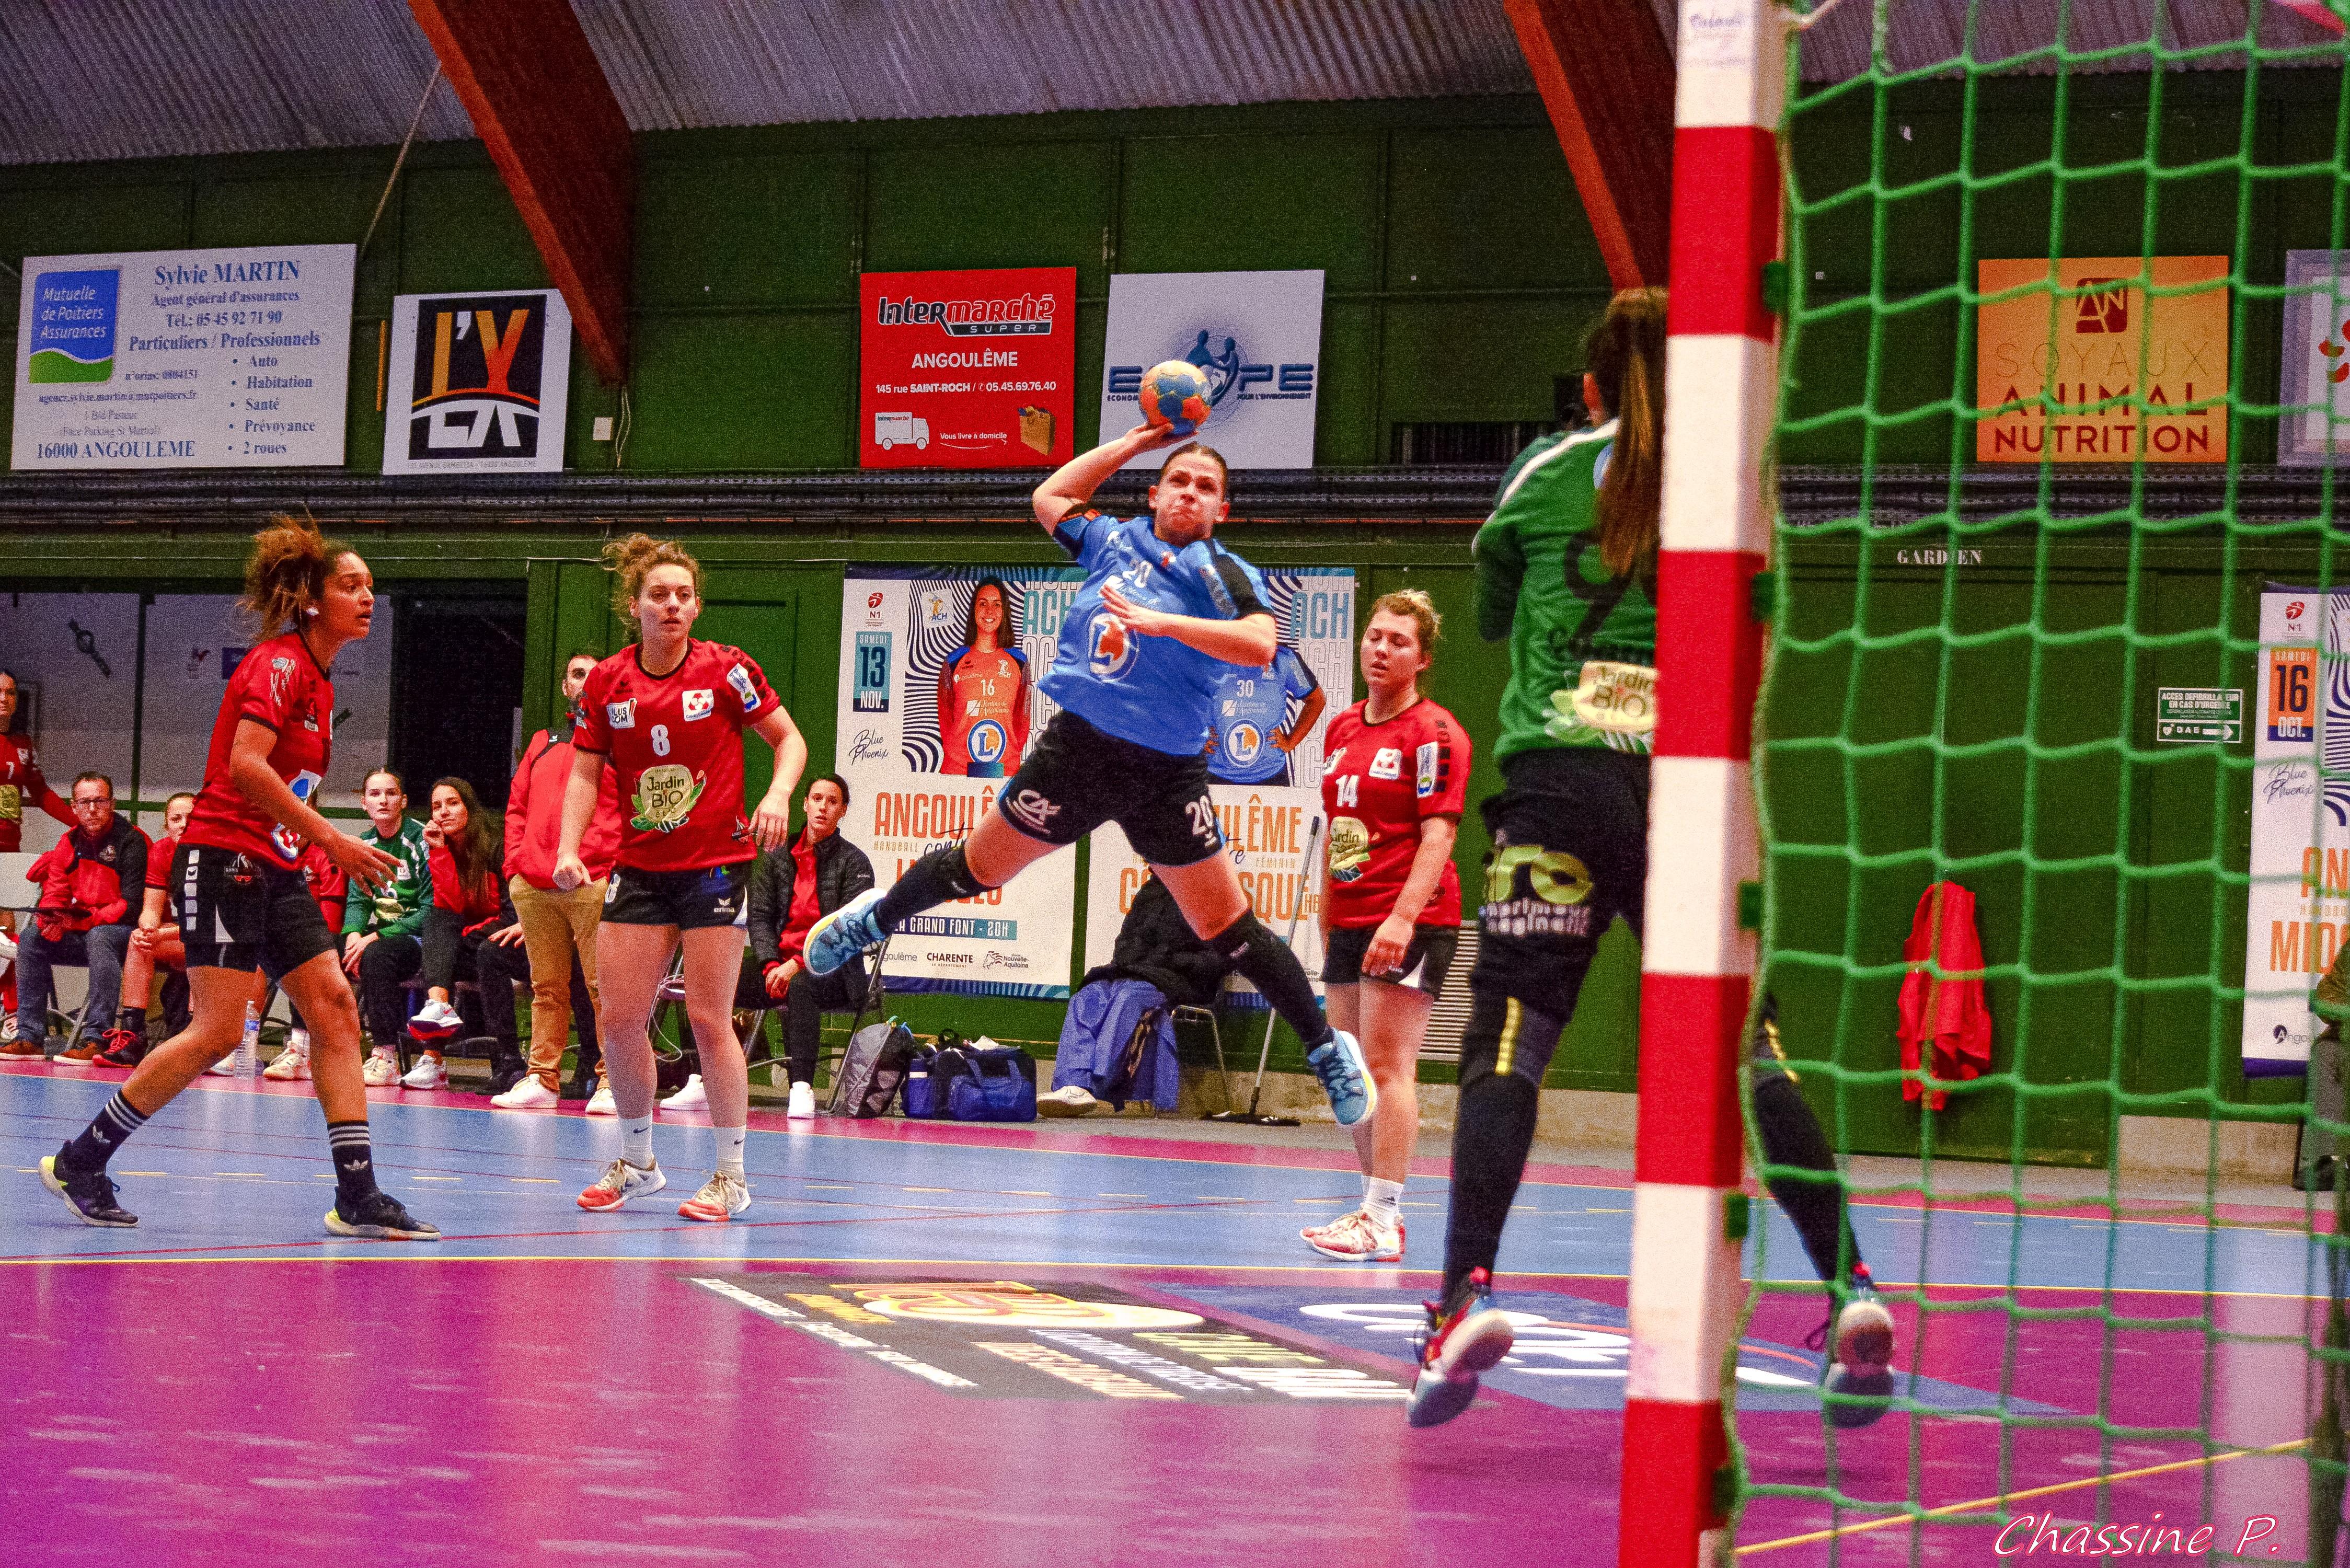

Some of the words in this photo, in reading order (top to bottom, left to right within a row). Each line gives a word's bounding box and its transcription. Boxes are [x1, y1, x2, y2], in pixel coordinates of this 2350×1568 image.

[155, 264, 208, 290] Sylvie
[214, 260, 299, 283] MARTIN
[43, 285, 96, 302] Mutuelle
[151, 294, 183, 308] Agent
[186, 291, 226, 308] général
[229, 290, 300, 303] d'assurances
[42, 307, 55, 321] de
[57, 305, 103, 321] Poitiers
[196, 313, 211, 326] 05
[213, 312, 228, 326] 45
[232, 312, 246, 325] 92
[250, 311, 263, 324] 71
[267, 310, 282, 324] 90
[877, 293, 1056, 335] Intermarché
[40, 324, 106, 339] Assurances
[129, 334, 208, 351] Particuliers
[220, 330, 321, 348] Professionnels
[250, 355, 278, 367] Auto
[911, 348, 1018, 369] ANGOULÊME
[1995, 342, 2209, 377] SOYAUX
[246, 375, 313, 389] Habitation
[876, 384, 892, 394] 145
[910, 383, 971, 393] SAINT-ROCH
[986, 381, 1057, 393] 05.45.69.76.40
[245, 397, 279, 411] Santé
[1997, 382, 2209, 417] ANIMAL
[244, 418, 316, 436] Prévoyance
[979, 431, 1007, 440] domicile
[243, 441, 250, 455] 2
[253, 443, 287, 455] roues
[1995, 425, 2209, 453] NUTRITION
[37, 442, 78, 459] 16000
[81, 440, 195, 459] ANGOULEME
[1123, 559, 1153, 588] 20
[931, 613, 948, 621] ACH
[1290, 592, 1350, 640] ACH
[2287, 624, 2301, 632] N1
[859, 633, 888, 645] SAMEDI
[2275, 651, 2310, 661] SAMEDI
[860, 645, 886, 688] 13
[980, 678, 995, 697] 16
[1236, 679, 1254, 698] 30
[2276, 665, 2309, 712] 16
[860, 690, 884, 710] NOV.
[611, 714, 628, 723] COM
[2277, 716, 2306, 738] OCT.
[650, 724, 671, 756] 8
[854, 729, 884, 748] Blue
[849, 744, 889, 766] Phoenix
[6, 760, 15, 780] 7
[2268, 763, 2307, 780] Blue
[647, 776, 684, 792] Jardin
[1335, 774, 1360, 808] 14
[2263, 779, 2317, 804] Phoenix
[874, 785, 995, 840] ANGOULÊ
[1185, 795, 1214, 836] 20
[874, 840, 918, 852] HANDBALL
[895, 918, 906, 932] A
[909, 917, 946, 934] GRAND
[949, 919, 976, 936] FONT
[987, 921, 1008, 937] 20H
[883, 952, 918, 962] goulême
[926, 952, 973, 963] CHARENTE
